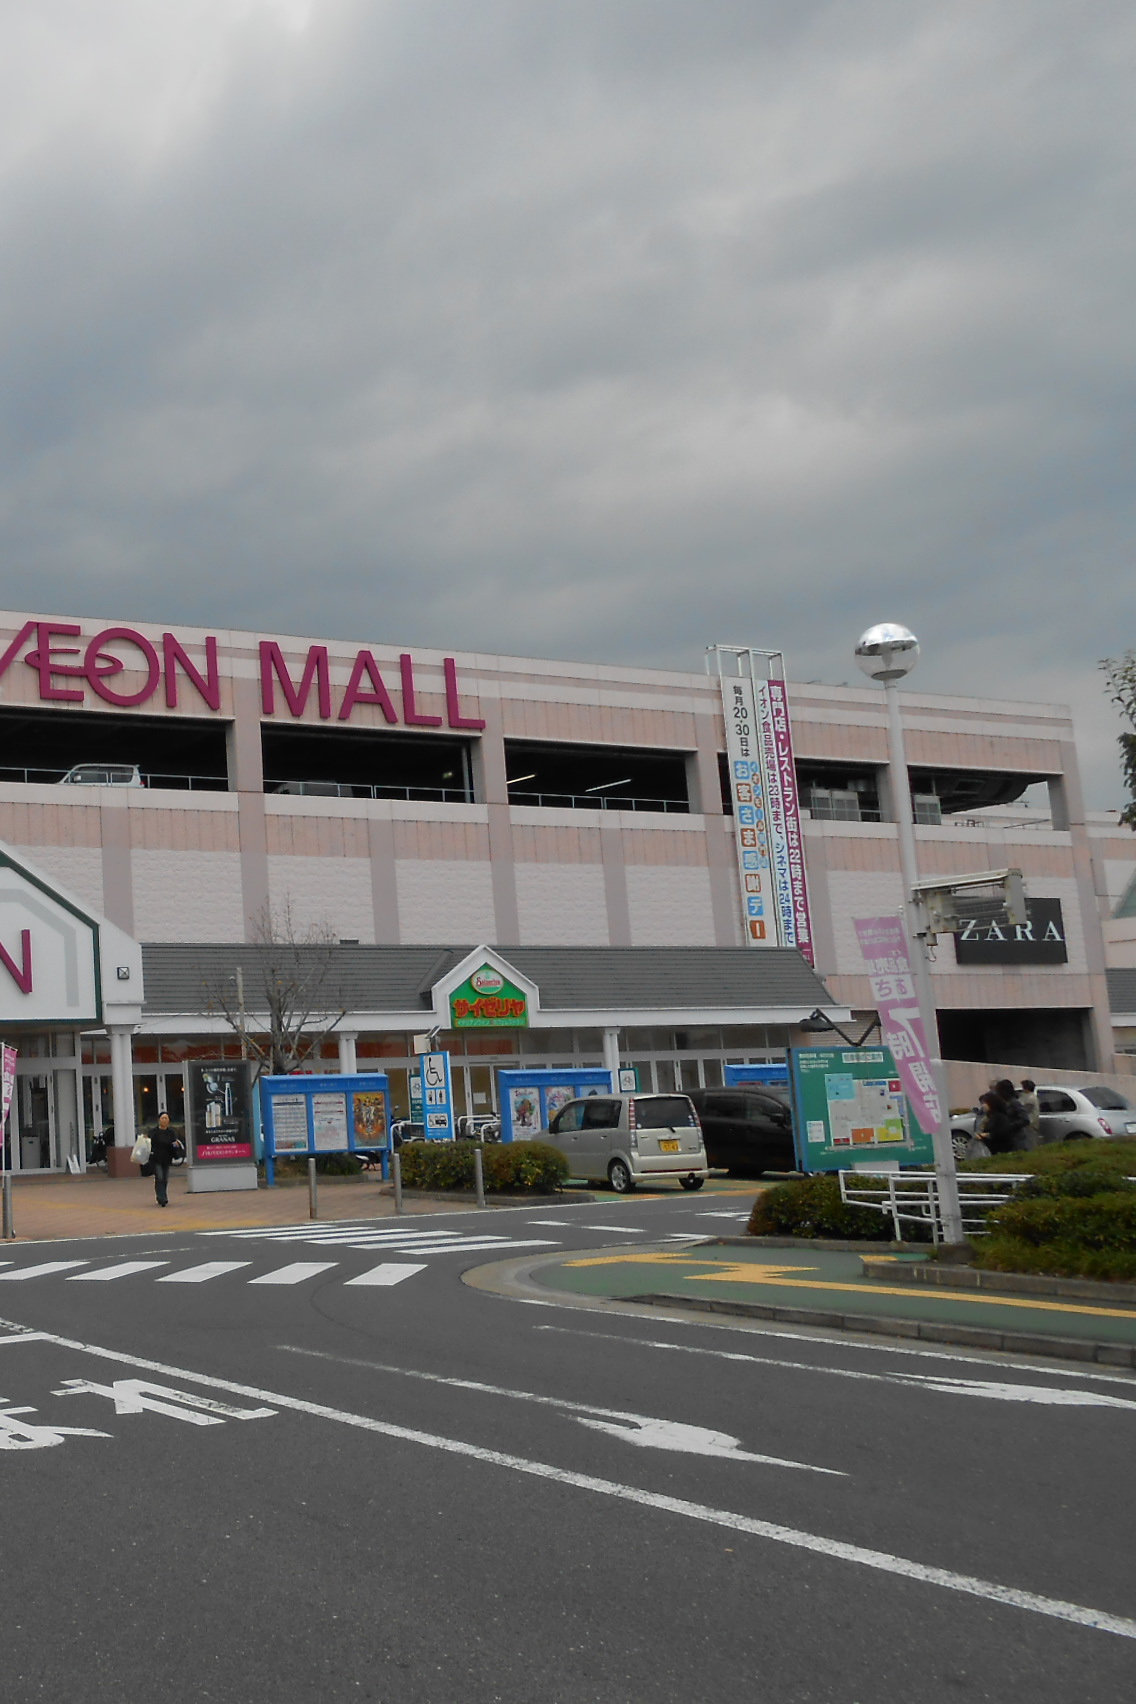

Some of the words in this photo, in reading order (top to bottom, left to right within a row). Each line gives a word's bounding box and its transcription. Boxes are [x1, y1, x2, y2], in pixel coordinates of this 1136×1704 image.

[258, 640, 487, 730] MALL
[959, 919, 1065, 942] ZARA
[454, 997, 526, 1018] サイゼリヤ
